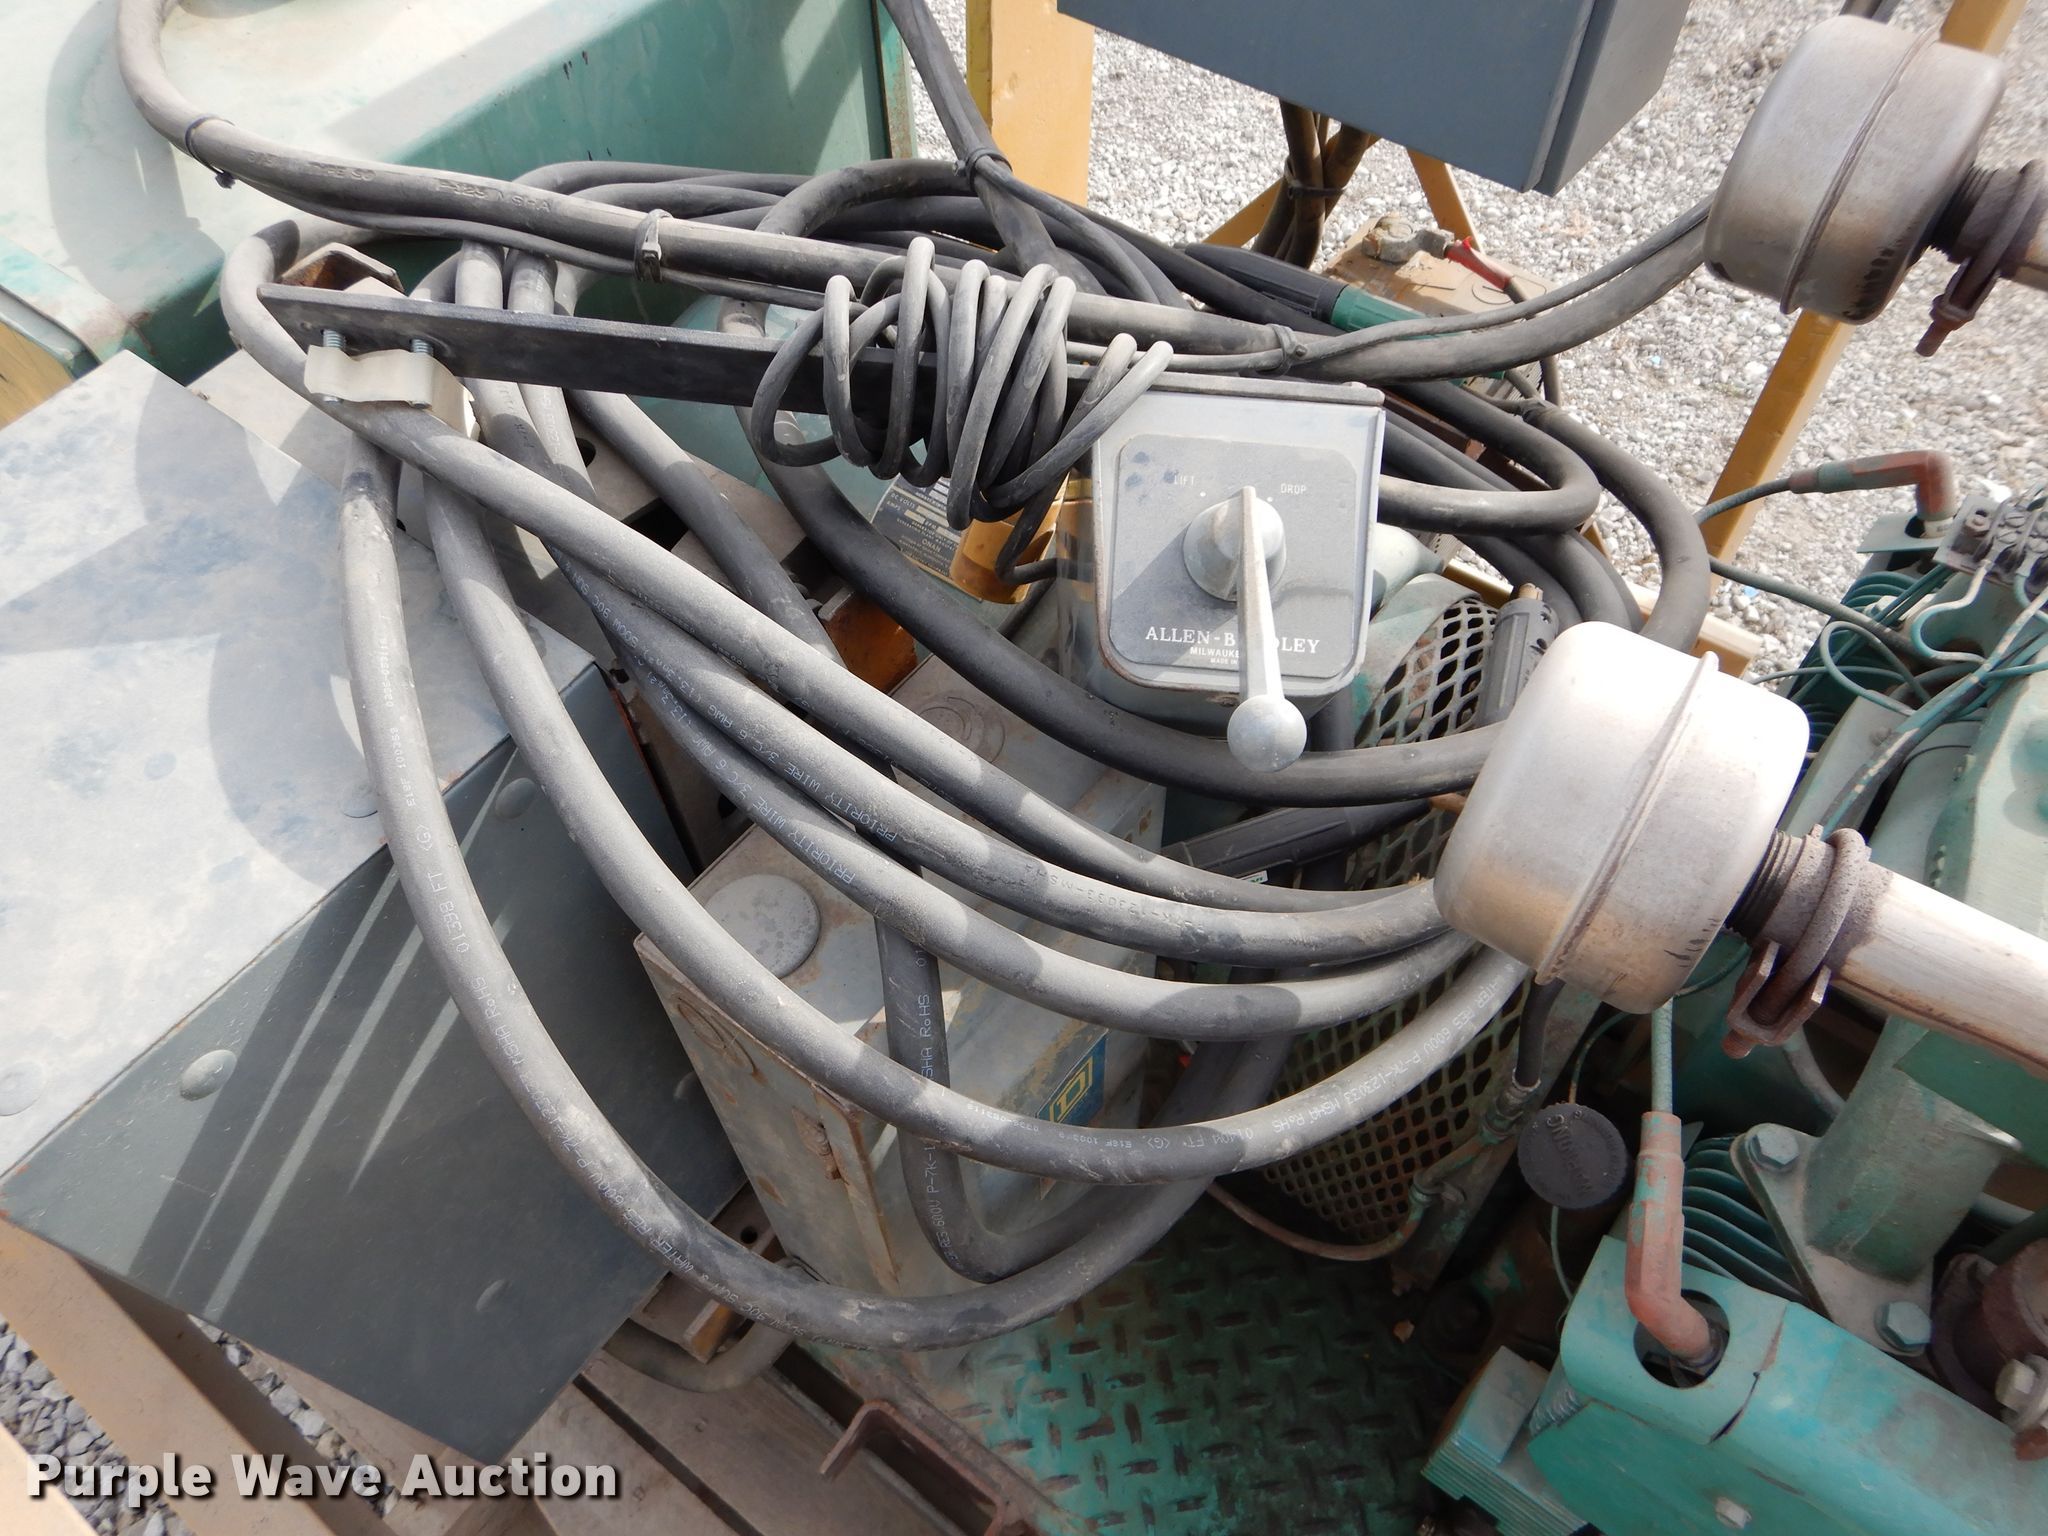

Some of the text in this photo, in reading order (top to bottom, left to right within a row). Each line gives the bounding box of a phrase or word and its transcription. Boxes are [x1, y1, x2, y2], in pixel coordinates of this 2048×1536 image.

[1173, 474, 1195, 487] LIFT
[1280, 483, 1307, 495] DROP
[1145, 626, 1321, 654] ALLEN-BLEY
[1190, 646, 1239, 658] MILWAUKE
[706, 703, 733, 728] AWG
[736, 728, 748, 740] 6
[714, 757, 728, 771] 6
[751, 739, 779, 764] 3/C
[724, 768, 753, 799] 3/C
[783, 761, 821, 792] WIRE
[750, 795, 789, 830] WIRE
[824, 792, 898, 842] PRIORITY
[786, 826, 856, 885] PRIORITY
[426, 867, 448, 893] FT
[469, 974, 501, 1020] RoHS
[491, 1022, 528, 1069] MSHA
[918, 993, 933, 1078] SHA RoHS
[1342, 1049, 1422, 1104] P-7K-123033
[1270, 1111, 1305, 1133] RoHS
[1187, 1132, 1205, 1149] FT
[649, 1234, 695, 1275] WATER
